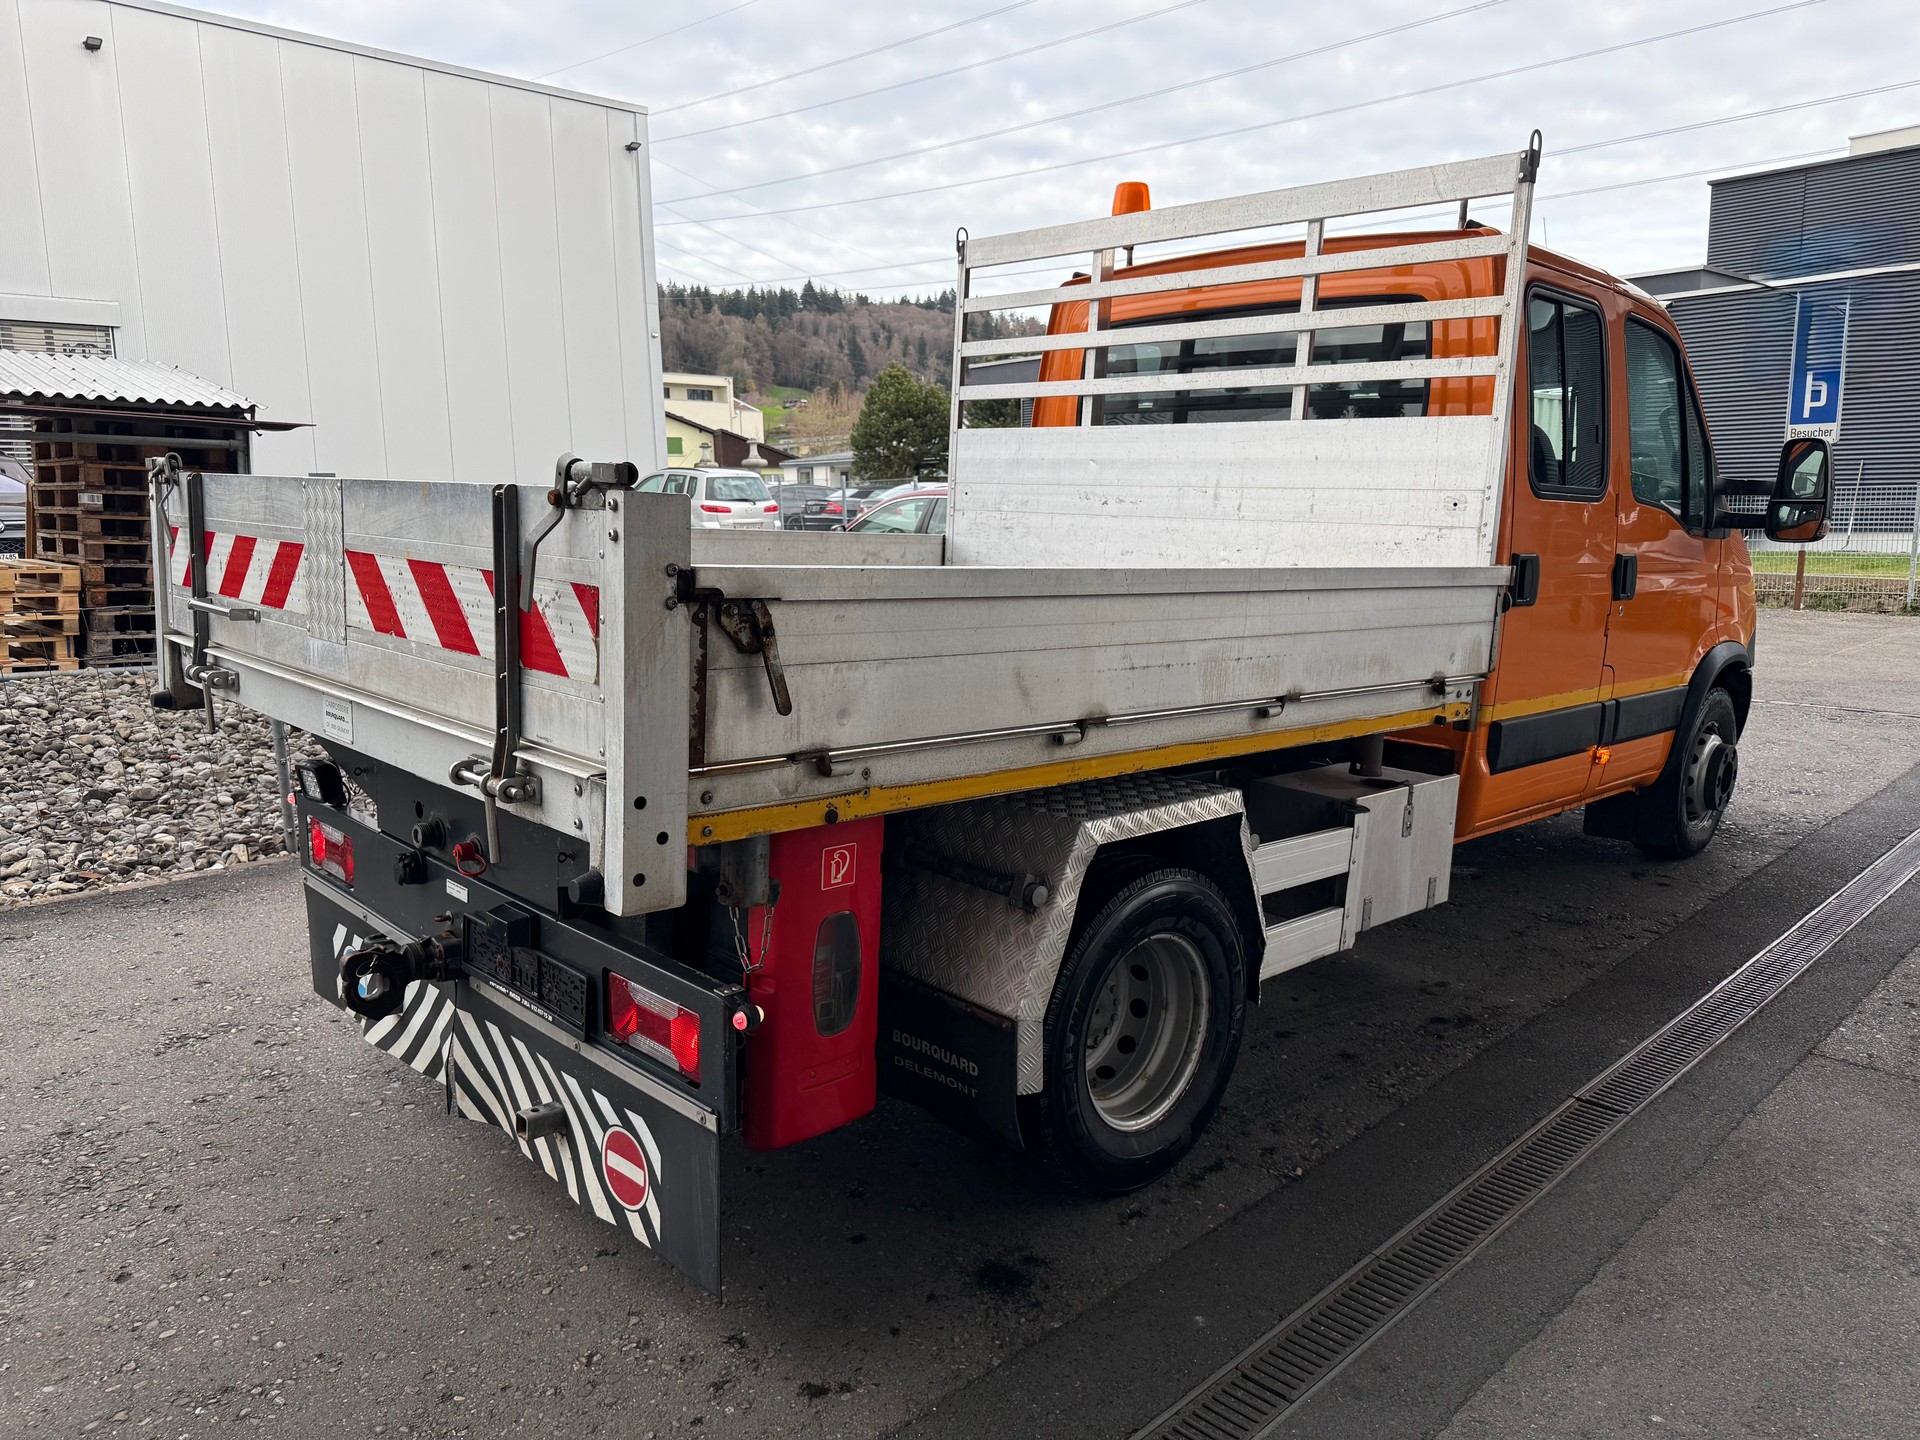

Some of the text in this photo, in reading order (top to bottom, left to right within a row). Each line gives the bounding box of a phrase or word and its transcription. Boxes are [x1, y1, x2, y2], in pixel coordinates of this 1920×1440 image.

[1802, 371, 1828, 418] P
[1790, 427, 1834, 438] Besucher
[892, 1029, 979, 1077] BOURQUARD
[894, 1055, 979, 1098] DELEMONT
